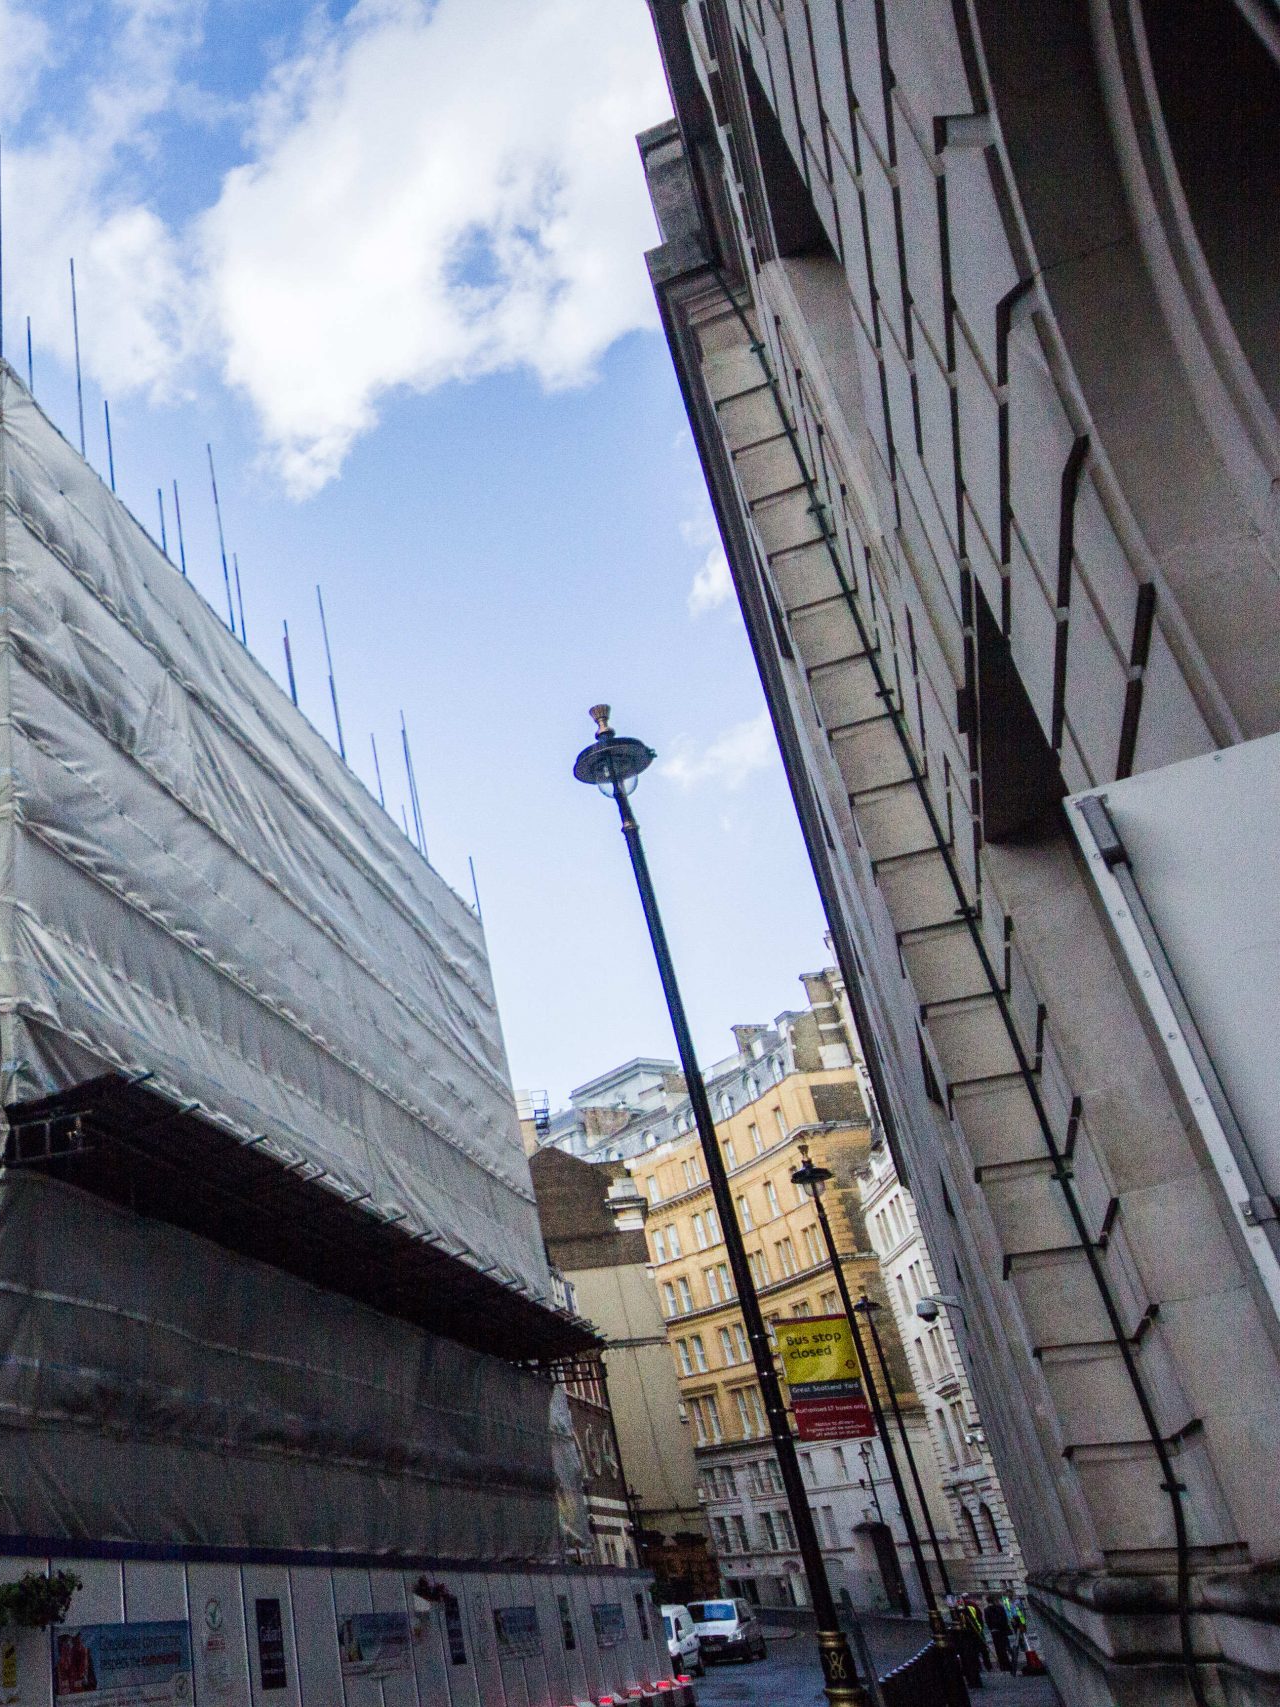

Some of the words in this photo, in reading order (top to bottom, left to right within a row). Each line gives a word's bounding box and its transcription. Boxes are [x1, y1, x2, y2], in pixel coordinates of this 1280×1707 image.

[786, 1335, 809, 1346] Bus
[812, 1332, 842, 1344] stop
[790, 1345, 832, 1359] closed
[791, 1386, 811, 1394] Great
[812, 1383, 842, 1392] Scotland
